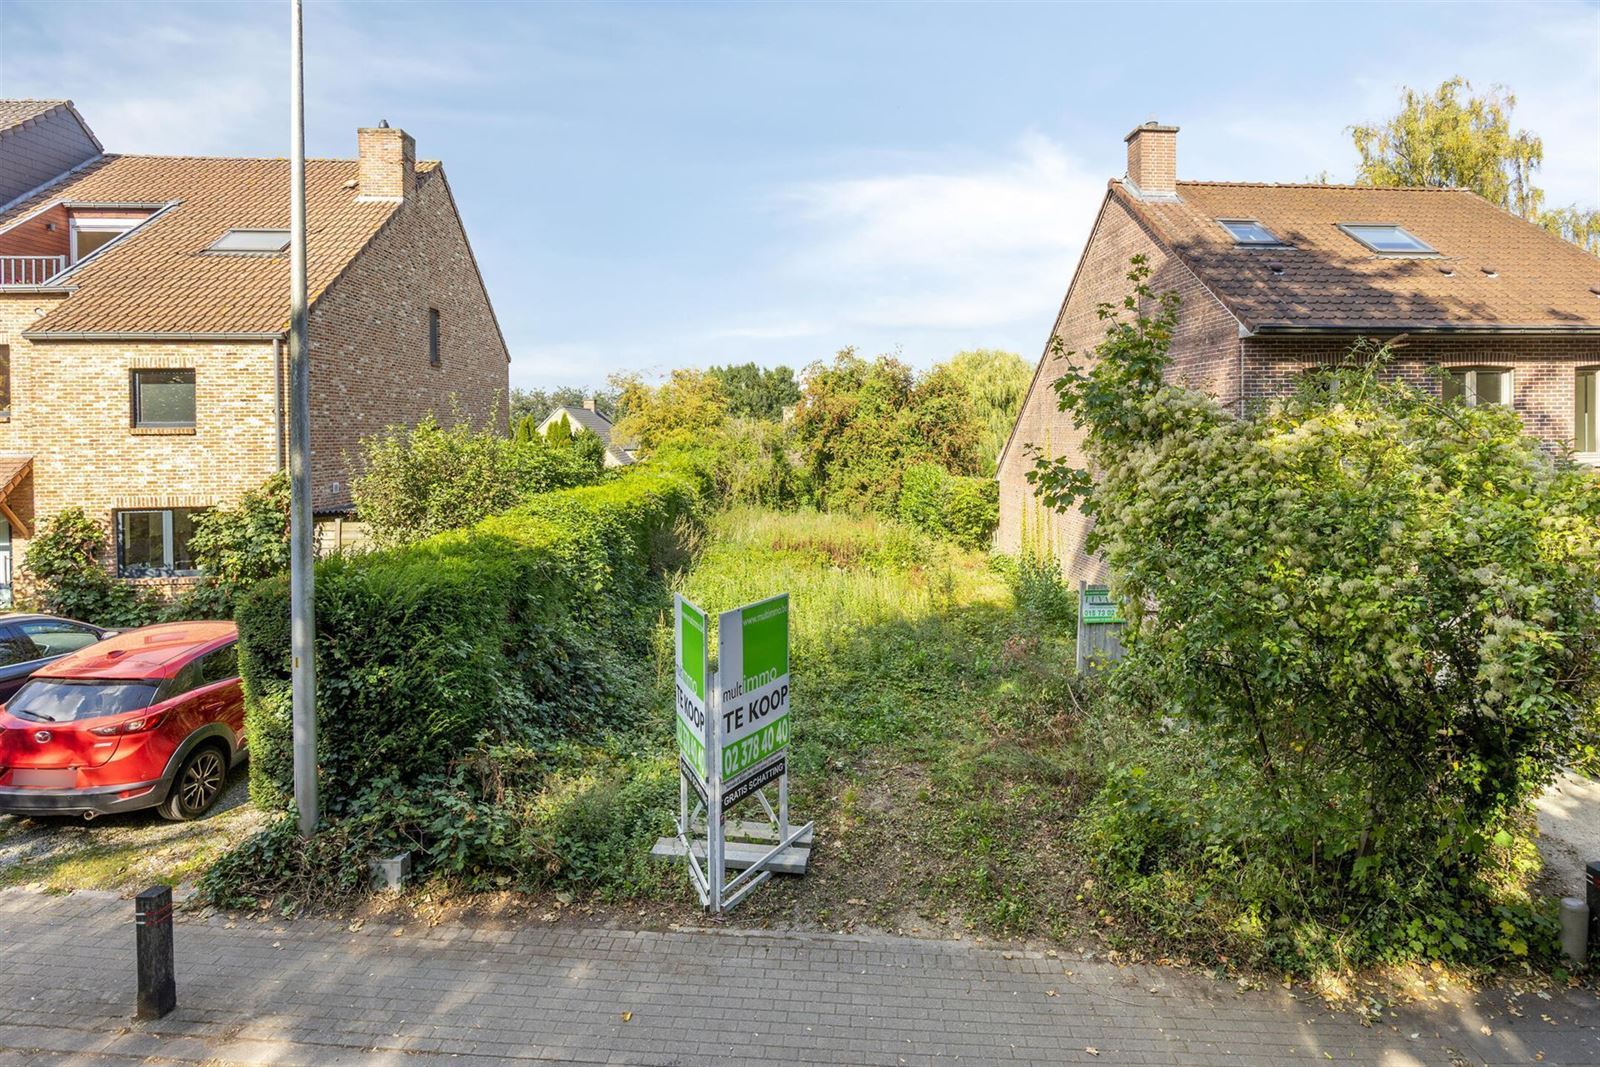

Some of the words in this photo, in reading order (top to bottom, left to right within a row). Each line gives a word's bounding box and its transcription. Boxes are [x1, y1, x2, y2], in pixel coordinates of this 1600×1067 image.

[676, 683, 684, 709] TE
[684, 694, 704, 732] KOOP
[723, 706, 744, 734] TE
[749, 684, 788, 723] KOOP
[724, 746, 739, 775] 02
[741, 734, 760, 766] 378
[761, 726, 774, 753] 40
[776, 718, 788, 744] 40
[723, 784, 748, 806] GRATIS
[748, 762, 784, 790] SCHATTING
